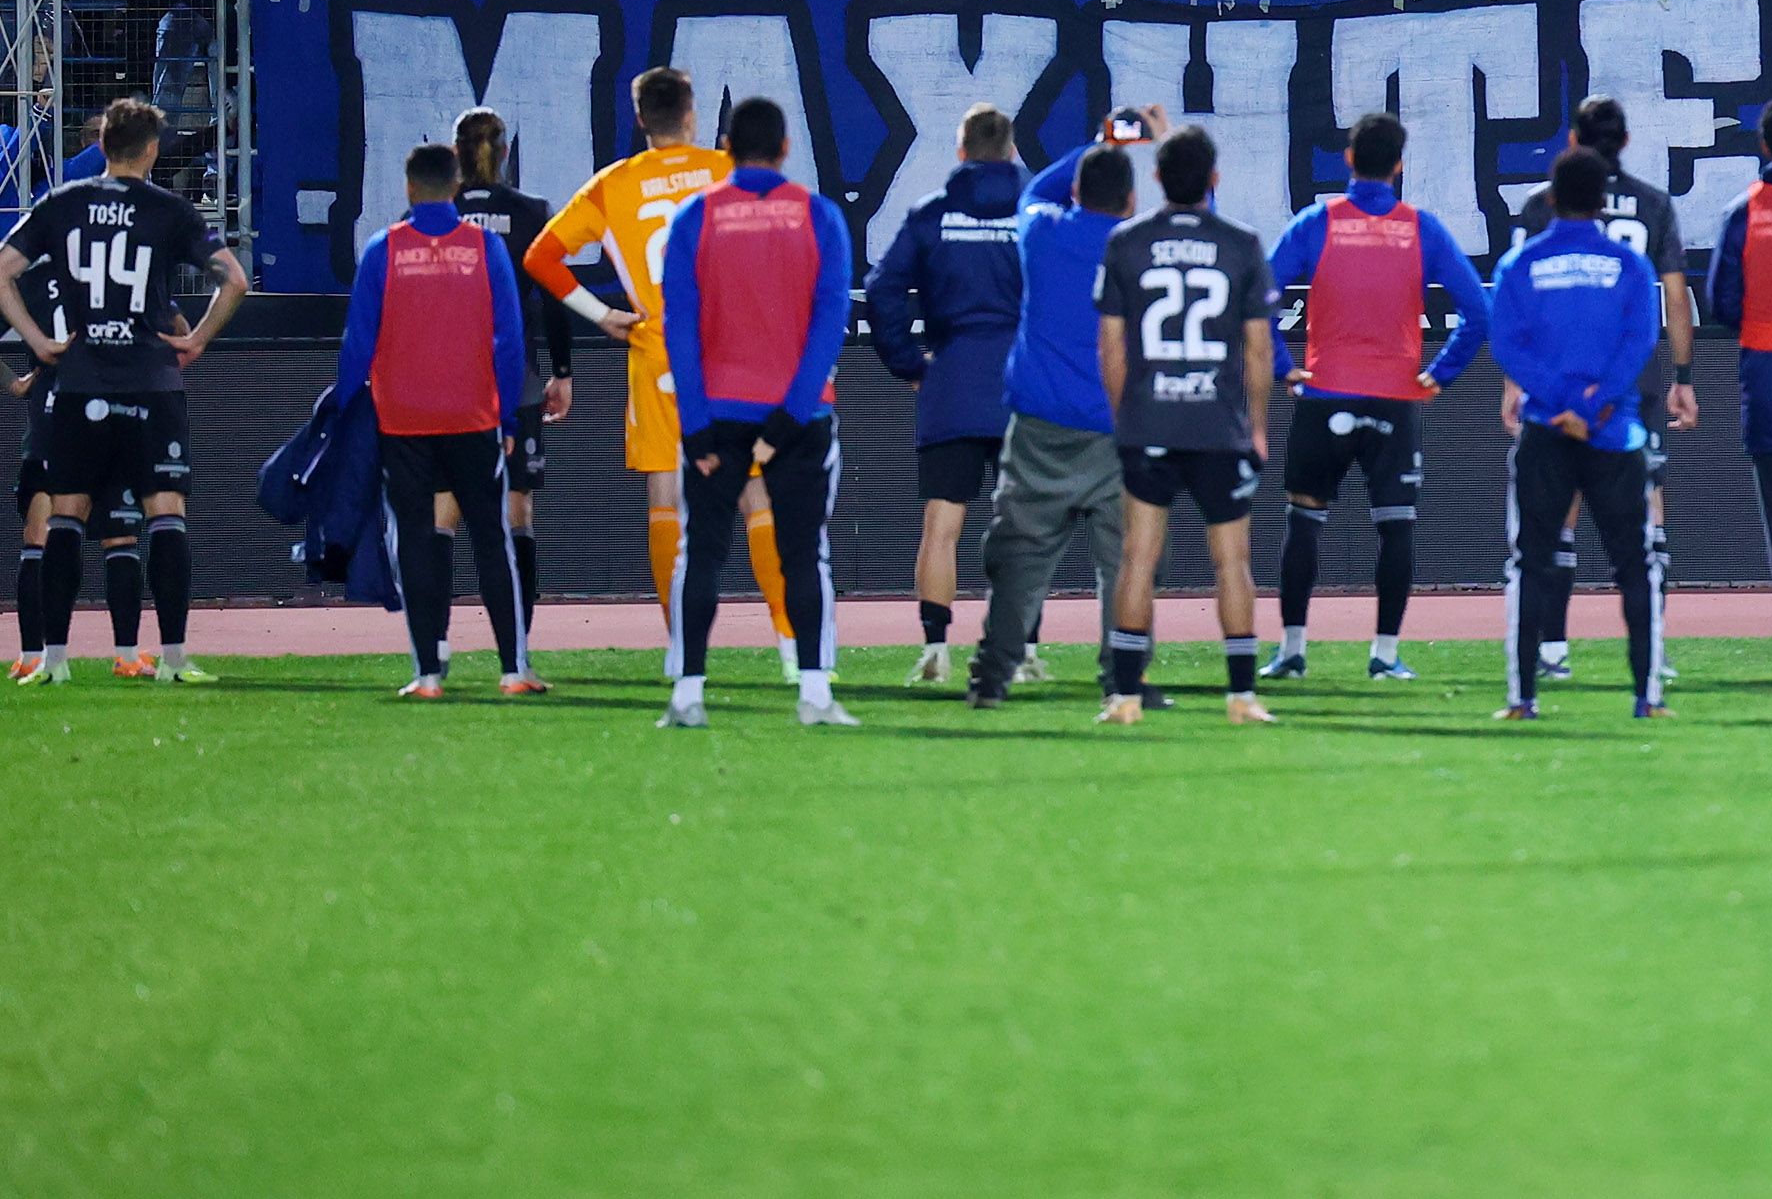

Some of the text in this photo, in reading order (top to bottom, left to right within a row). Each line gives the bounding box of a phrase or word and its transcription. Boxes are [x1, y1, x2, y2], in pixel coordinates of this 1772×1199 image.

[88, 202, 136, 227] TOŠIĆ
[66, 227, 153, 314] 44
[1139, 267, 1230, 361] 22
